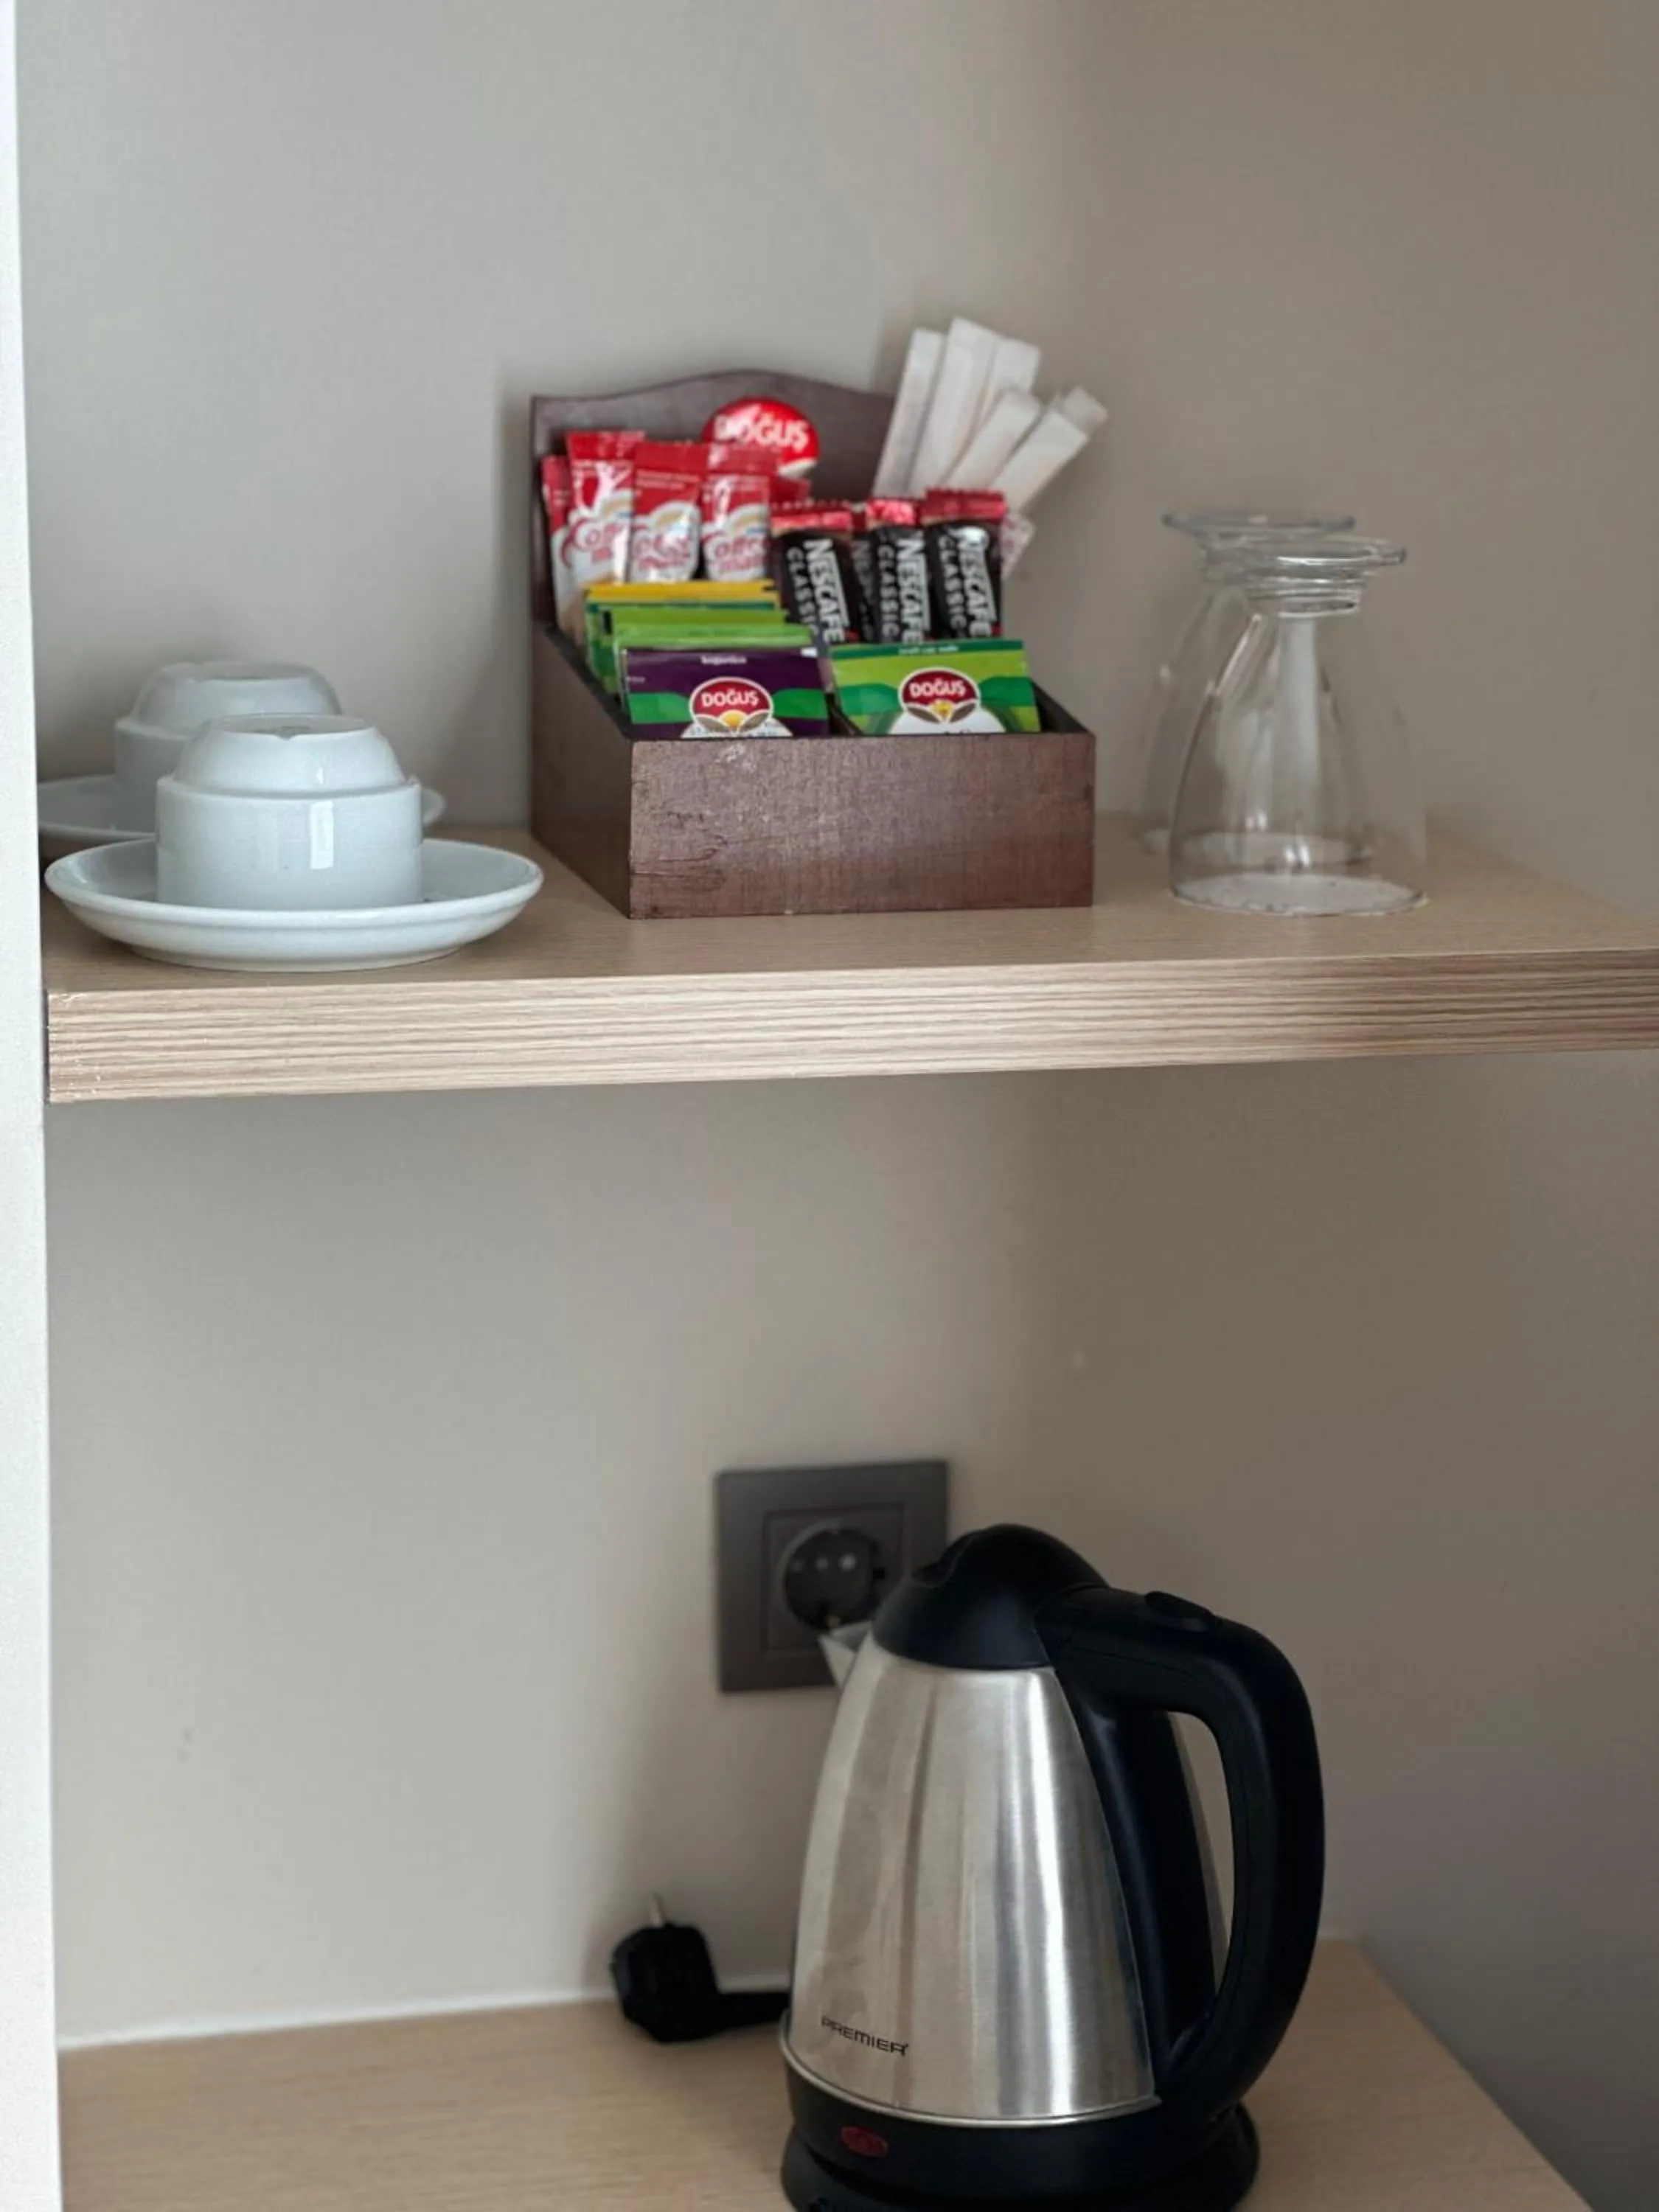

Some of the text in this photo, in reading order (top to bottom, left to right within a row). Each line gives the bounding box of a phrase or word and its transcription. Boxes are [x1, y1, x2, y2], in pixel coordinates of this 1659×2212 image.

[877, 544, 900, 636] CLASSIC
[939, 536, 967, 629] CLASSIC
[701, 688, 759, 708] DOĞUŞ
[821, 2017, 906, 2056] PREMIER
